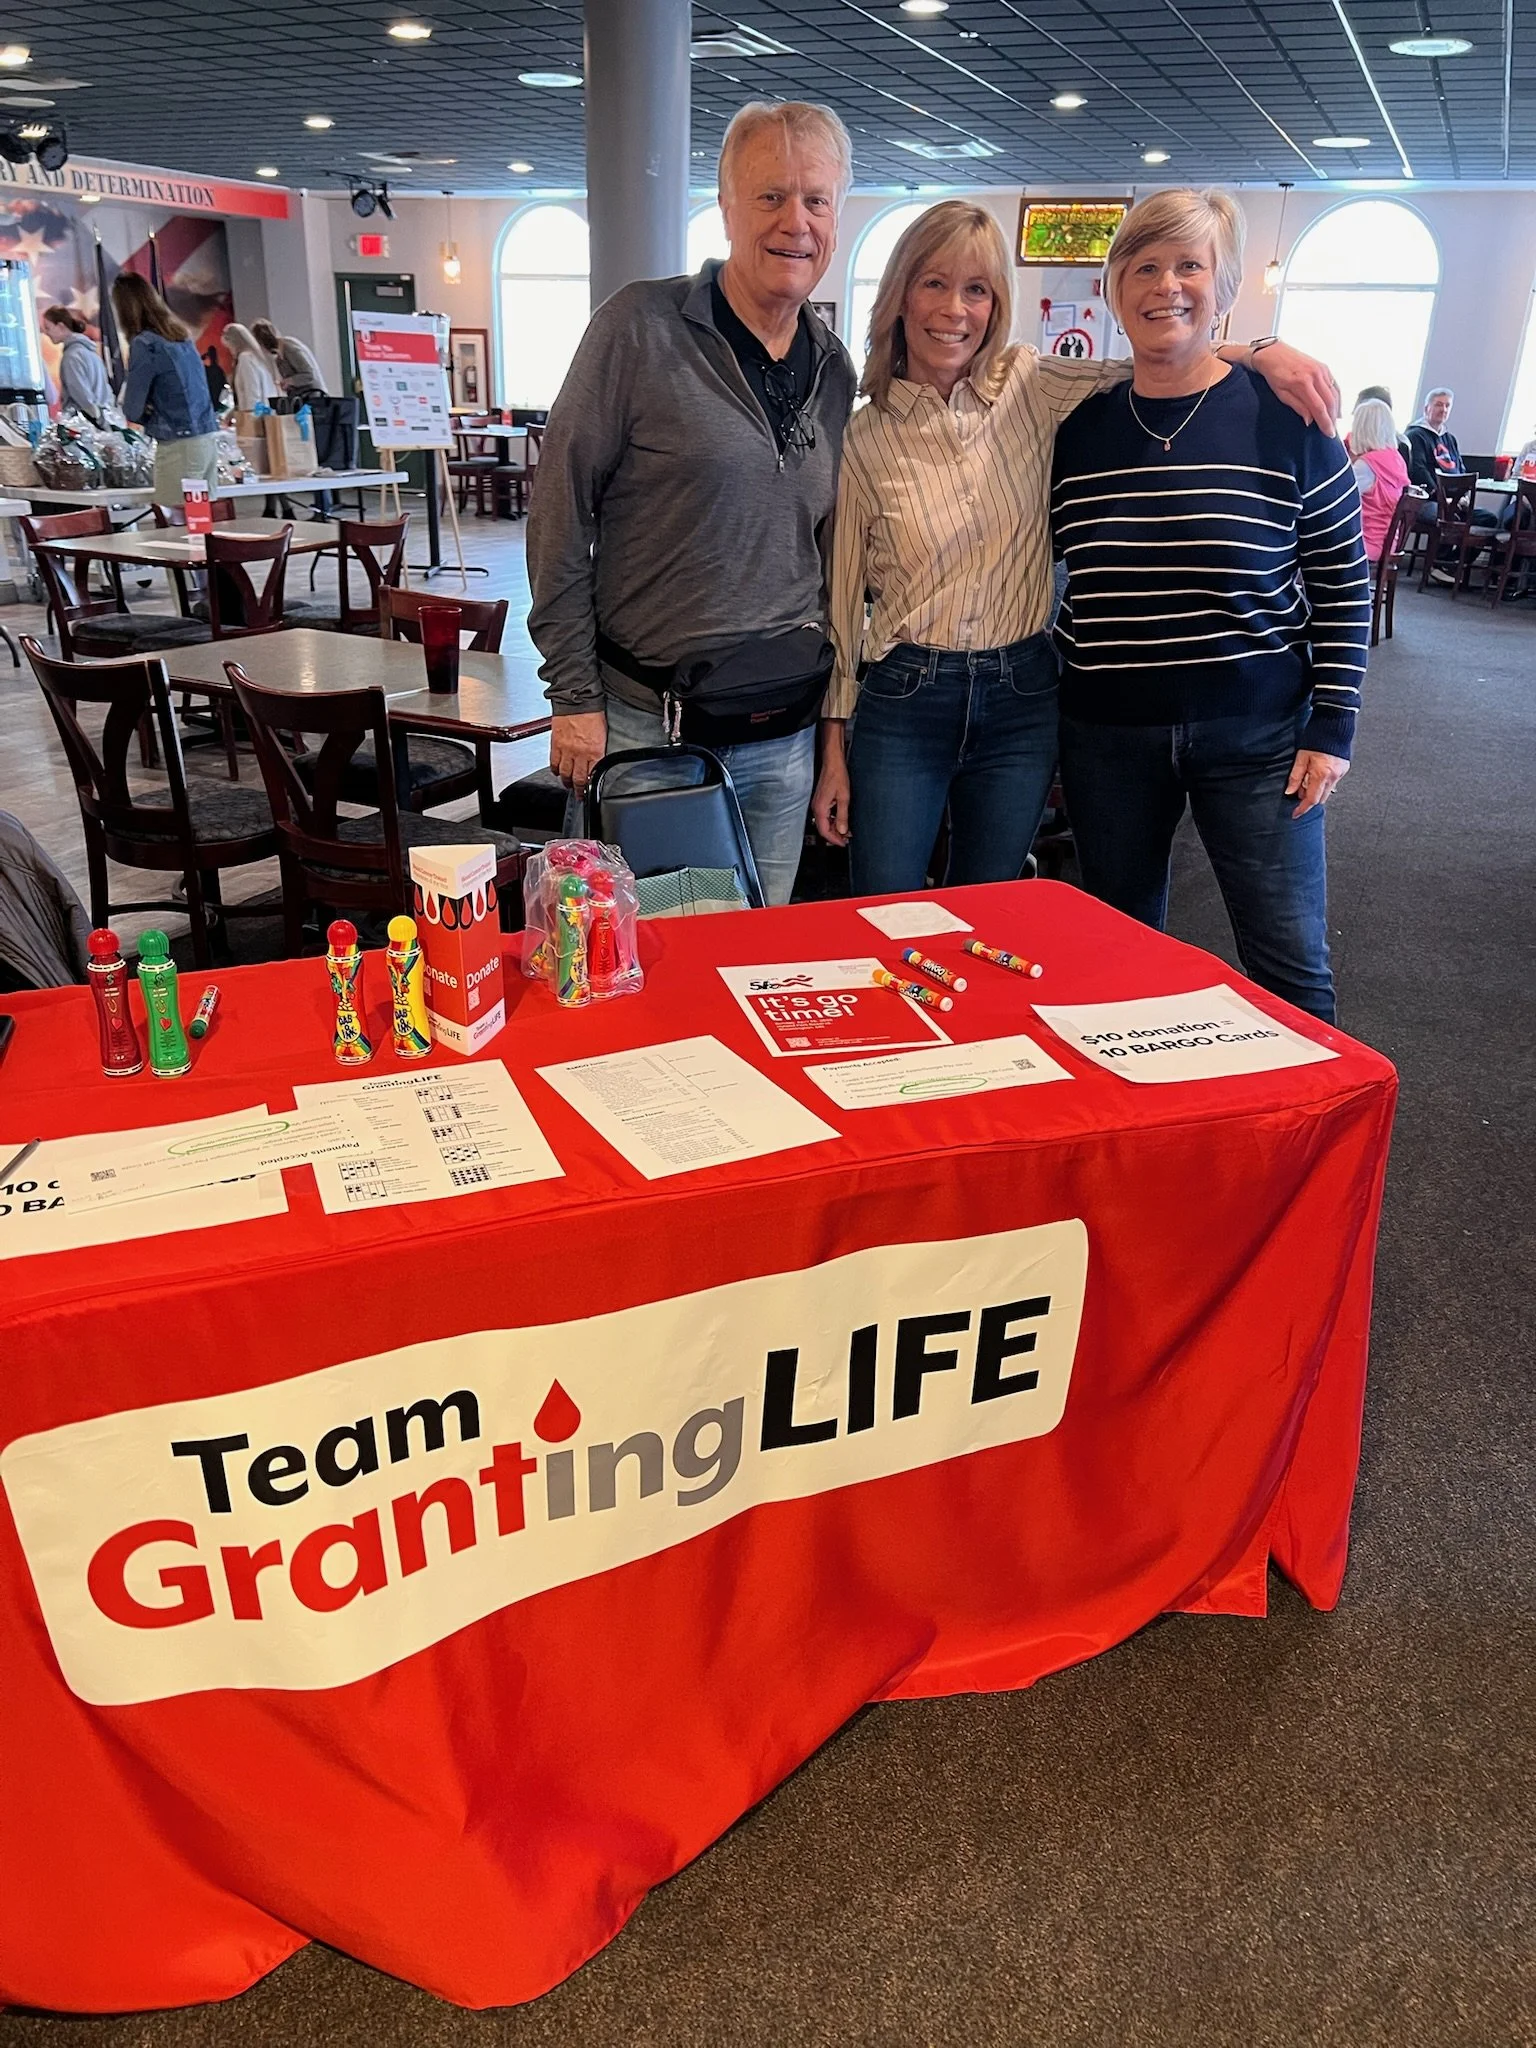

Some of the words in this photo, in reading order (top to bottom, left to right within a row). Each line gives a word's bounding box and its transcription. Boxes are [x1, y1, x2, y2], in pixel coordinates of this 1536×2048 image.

[27, 162, 65, 187] AND
[70, 170, 215, 207] DETERMINATION
[424, 964, 457, 989] onate
[466, 957, 499, 989] Donate
[758, 995, 810, 1009] It's
[816, 994, 858, 1009] go
[764, 1004, 855, 1022] time!
[1080, 1032, 1123, 1045] $10
[1127, 1020, 1219, 1040] donation
[1099, 1046, 1128, 1058] 10
[1128, 1036, 1214, 1055] BARGO
[1215, 1029, 1279, 1043] Cards
[258, 1152, 308, 1166] Accepted:
[311, 1142, 360, 1154] Payments
[0, 1181, 38, 1195] 10
[171, 1390, 480, 1514] Team
